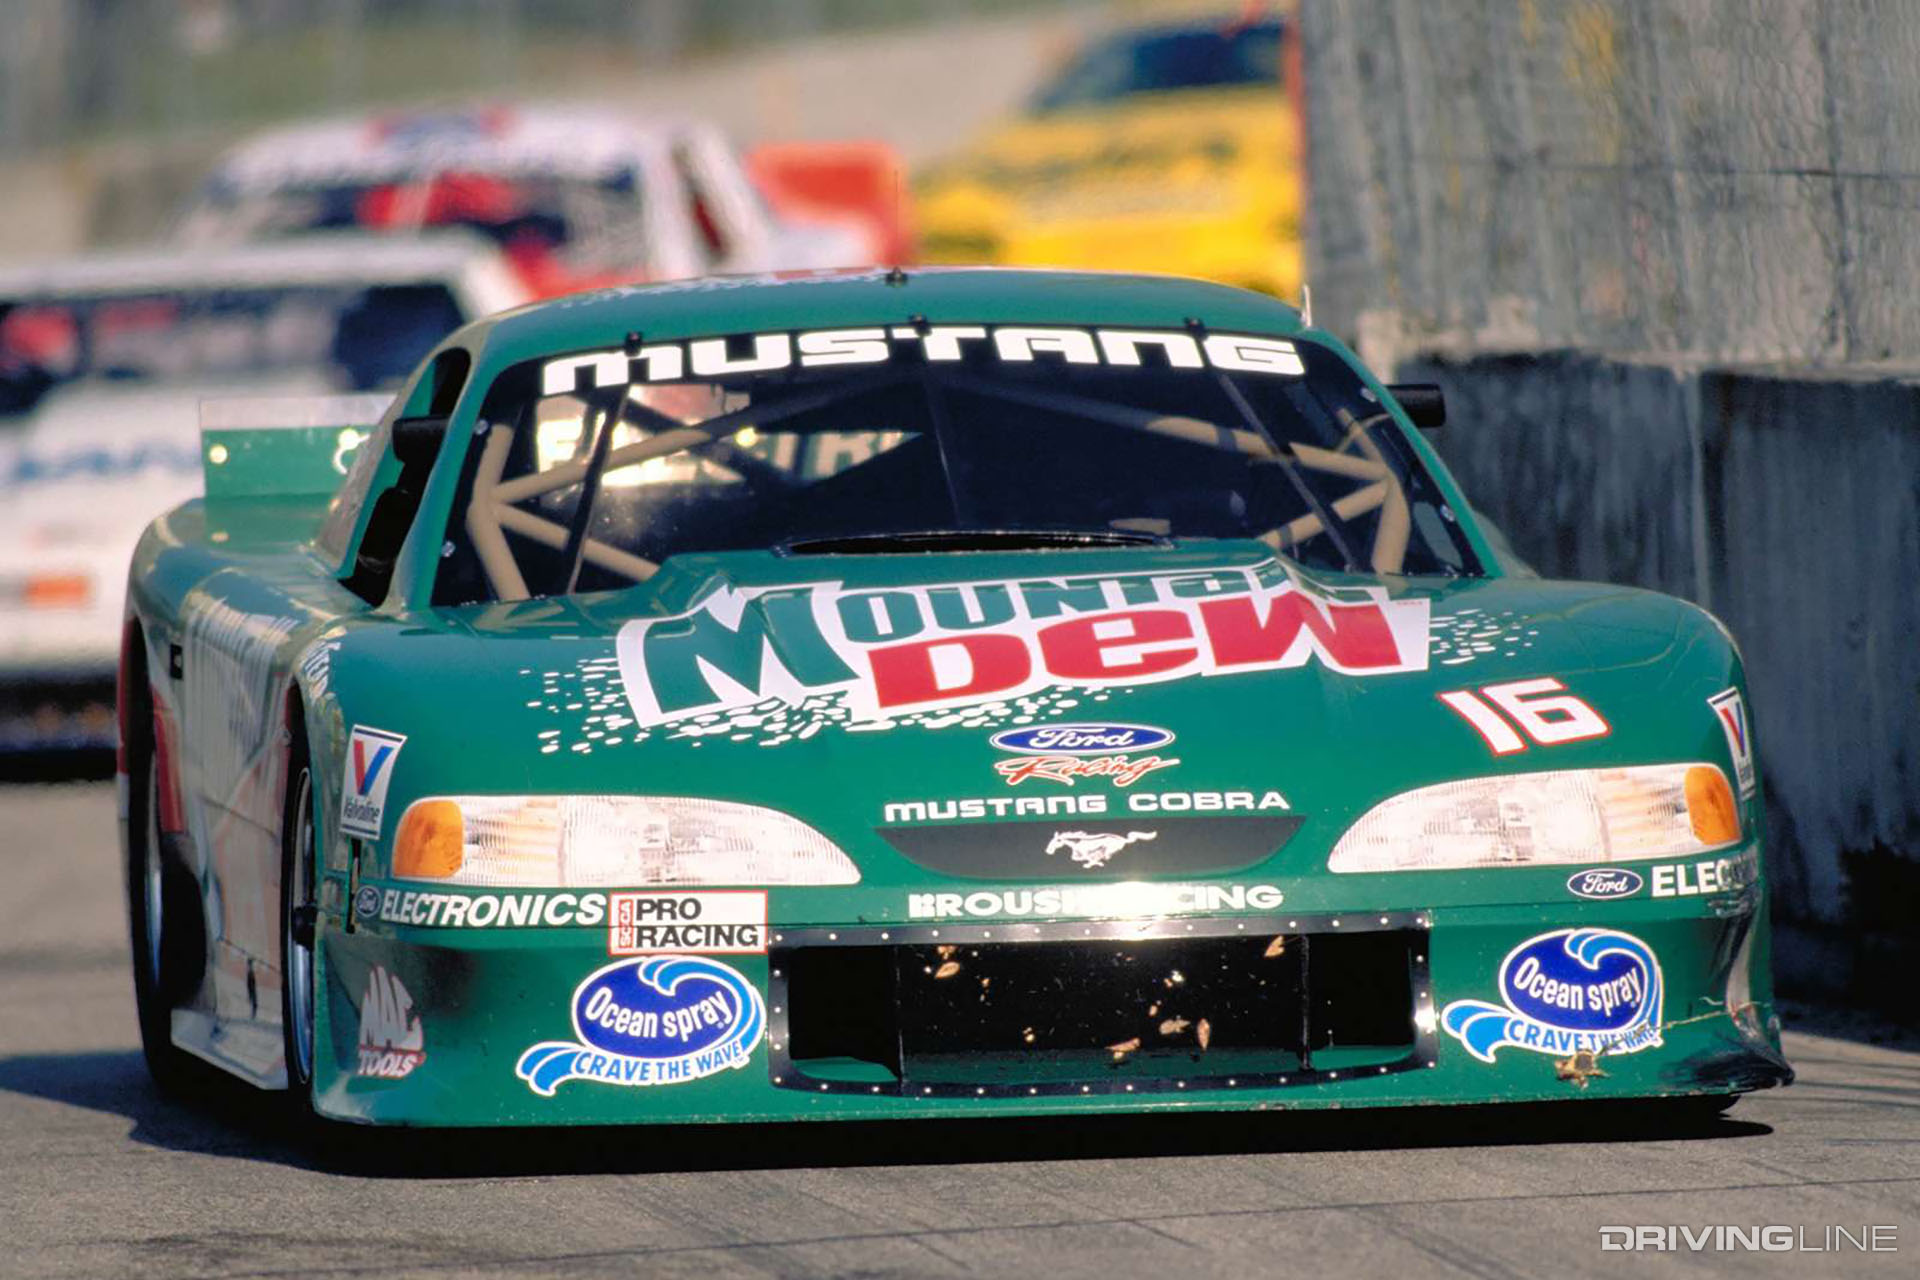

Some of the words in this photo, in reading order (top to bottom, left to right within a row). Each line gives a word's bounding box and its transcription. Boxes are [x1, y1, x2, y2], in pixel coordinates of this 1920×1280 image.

[543, 327, 1305, 395] MUSTANG
[1437, 676, 1613, 757] 16
[1029, 726, 1135, 749] Ford
[994, 755, 1181, 788] Racing
[884, 795, 1107, 823] MUSTANG
[1128, 791, 1291, 813] COBRA
[1582, 872, 1629, 894] Ford
[381, 889, 607, 929] ELECTRONICS
[636, 897, 703, 922] PRO
[636, 924, 760, 948] RACING
[1513, 956, 1584, 1011] Ocean
[1587, 967, 1642, 1017] spray
[585, 986, 659, 1039] Ocean
[662, 990, 733, 1043] spray
[1508, 1019, 1584, 1052] CRAVE
[358, 1051, 418, 1078] TOOLS
[574, 1050, 652, 1081] CRAVE
[655, 1060, 691, 1081] THE
[695, 1040, 741, 1074] WAVE
